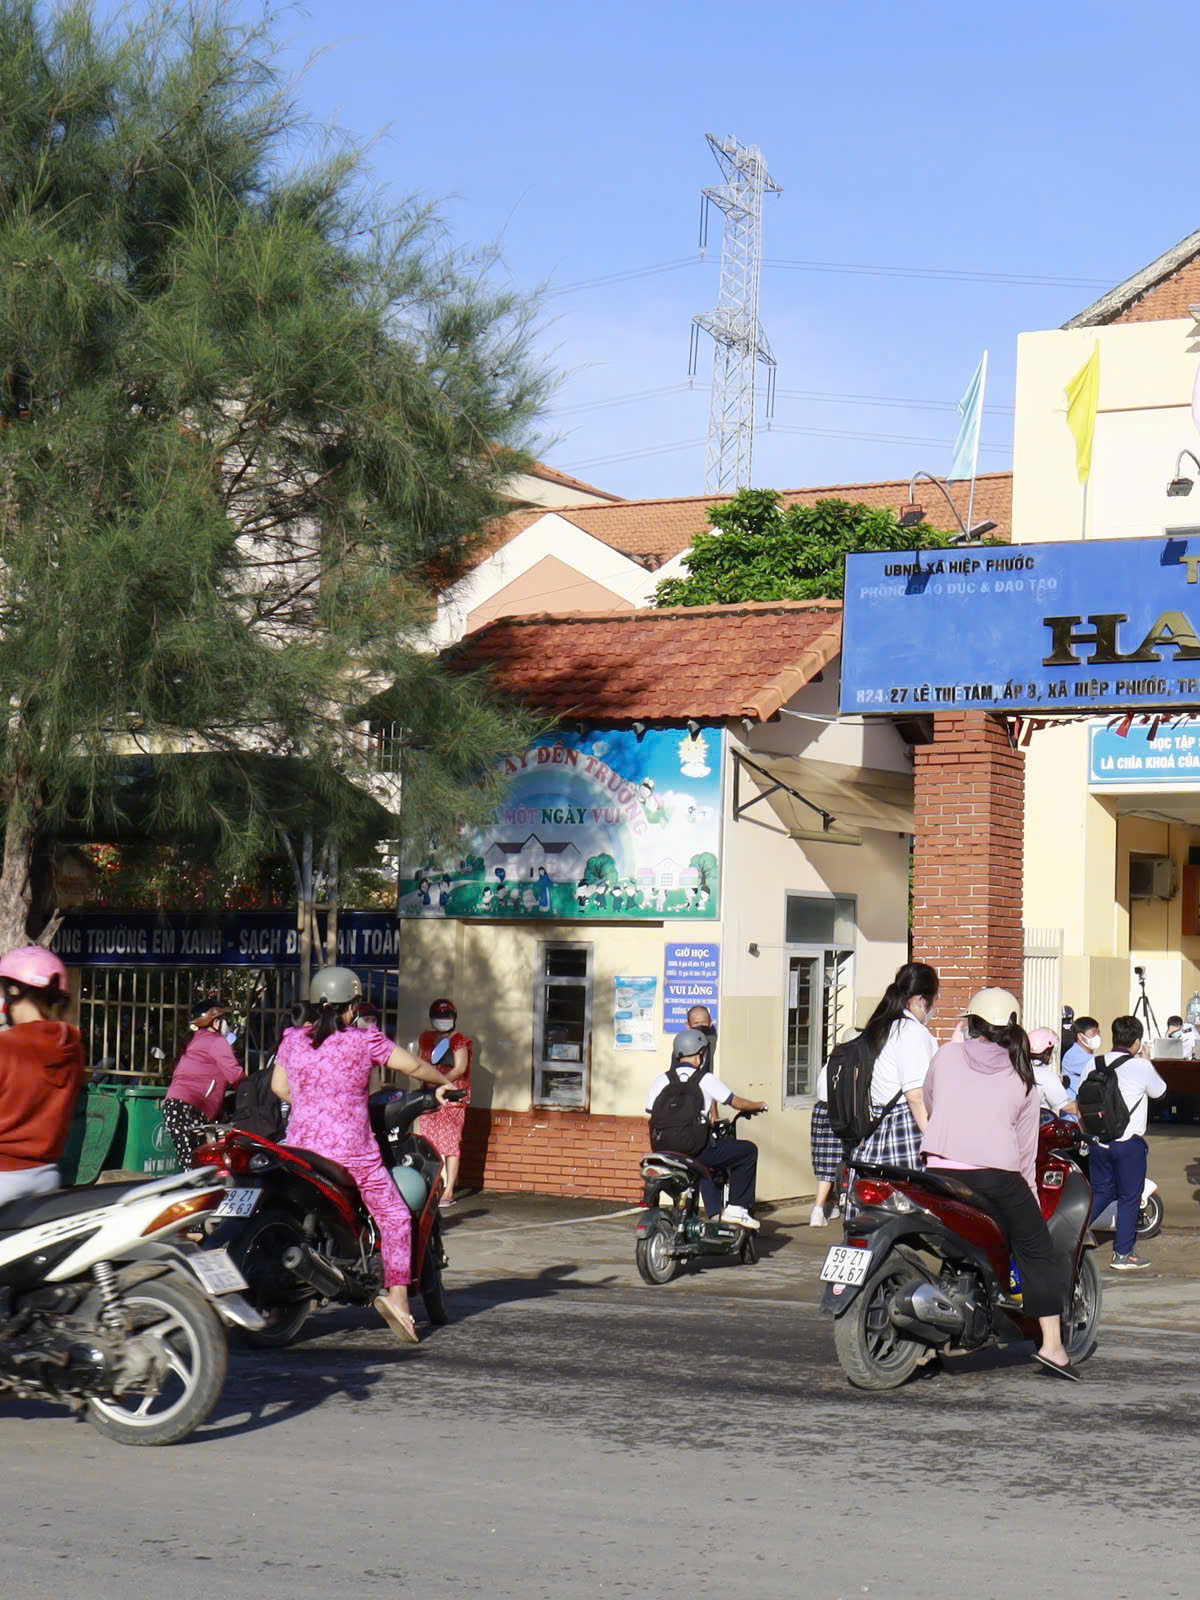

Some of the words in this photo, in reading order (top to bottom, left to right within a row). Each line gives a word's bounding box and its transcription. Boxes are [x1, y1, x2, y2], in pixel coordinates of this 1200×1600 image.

[926, 561, 944, 575] XÃ
[949, 557, 981, 577] HIỆP
[986, 553, 1034, 572] PHƯỚC
[980, 582, 990, 593] &
[890, 687, 908, 703] 27
[913, 683, 929, 703] LÊ
[1074, 677, 1109, 700] HIỆP
[1175, 734, 1196, 751] TẬP
[537, 738, 581, 767] ĐẾN
[1145, 753, 1175, 768] KHOÁ
[1178, 751, 1200, 768] CỦA
[541, 803, 588, 825] NGÀY
[592, 807, 621, 825] VUI
[152, 929, 175, 953] EM
[180, 929, 222, 954] XANH
[239, 929, 281, 960] SẠCH
[691, 949, 710, 959] HỌC
[669, 985, 686, 995] VUI
[687, 983, 713, 996] LÒNG
[832, 1248, 864, 1266] 59-Z1
[823, 1264, 864, 1283] 474.67
